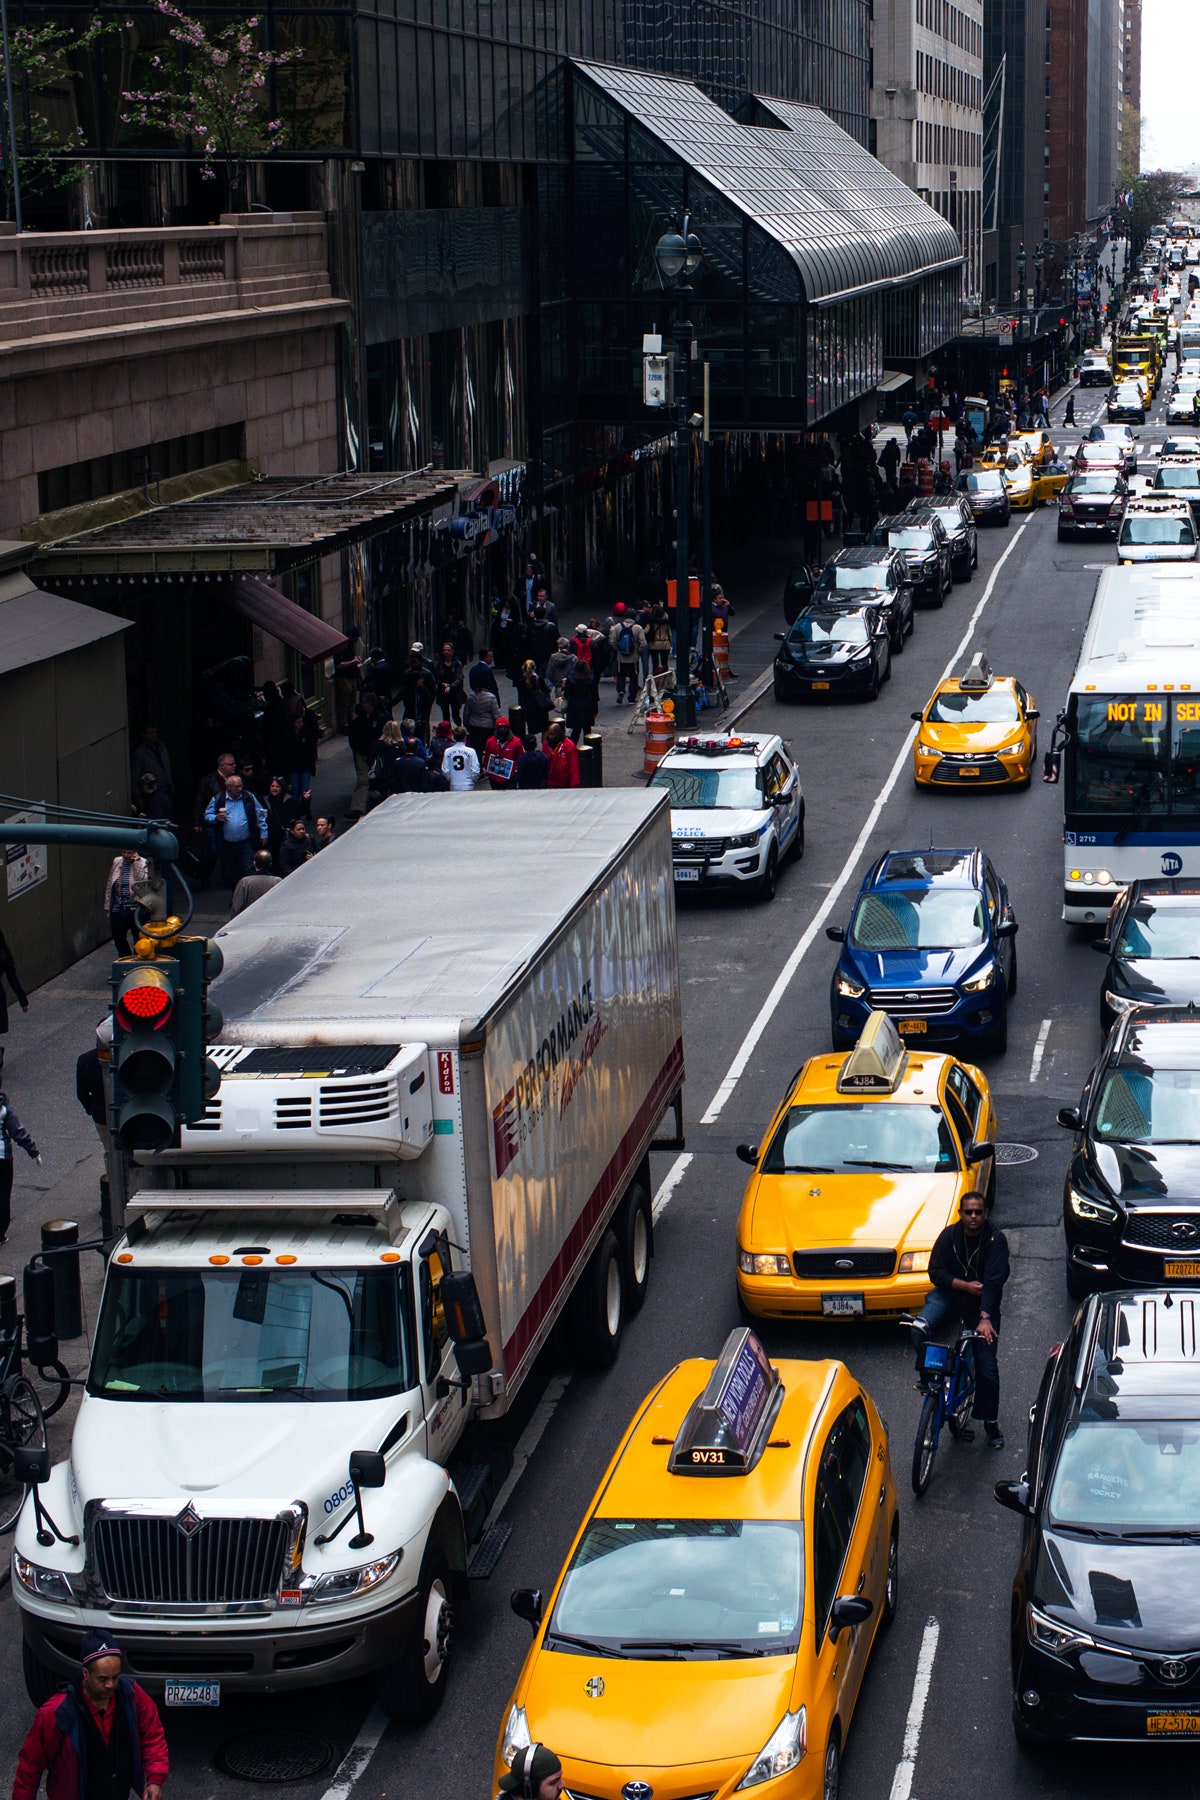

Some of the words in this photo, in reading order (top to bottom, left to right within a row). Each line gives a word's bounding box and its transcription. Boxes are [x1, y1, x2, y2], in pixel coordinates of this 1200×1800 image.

[464, 513, 488, 544] Capital
[1108, 703, 1137, 721] NOT
[1143, 703, 1162, 721] IN
[452, 755, 465, 771] 3
[1079, 835, 1097, 843] 2712
[516, 978, 594, 1121] PERFORMANCE
[441, 1053, 451, 1091] Kidron
[853, 1076, 875, 1085] 4J84
[1168, 1264, 1200, 1275] T720721C
[737, 1349, 756, 1387] DOLLS
[727, 1371, 747, 1405] YORK
[721, 1398, 738, 1425] NEW
[692, 1452, 725, 1463] 9V31
[1087, 1472, 1129, 1487] RANGERS
[167, 1686, 211, 1701] PRZ2548
